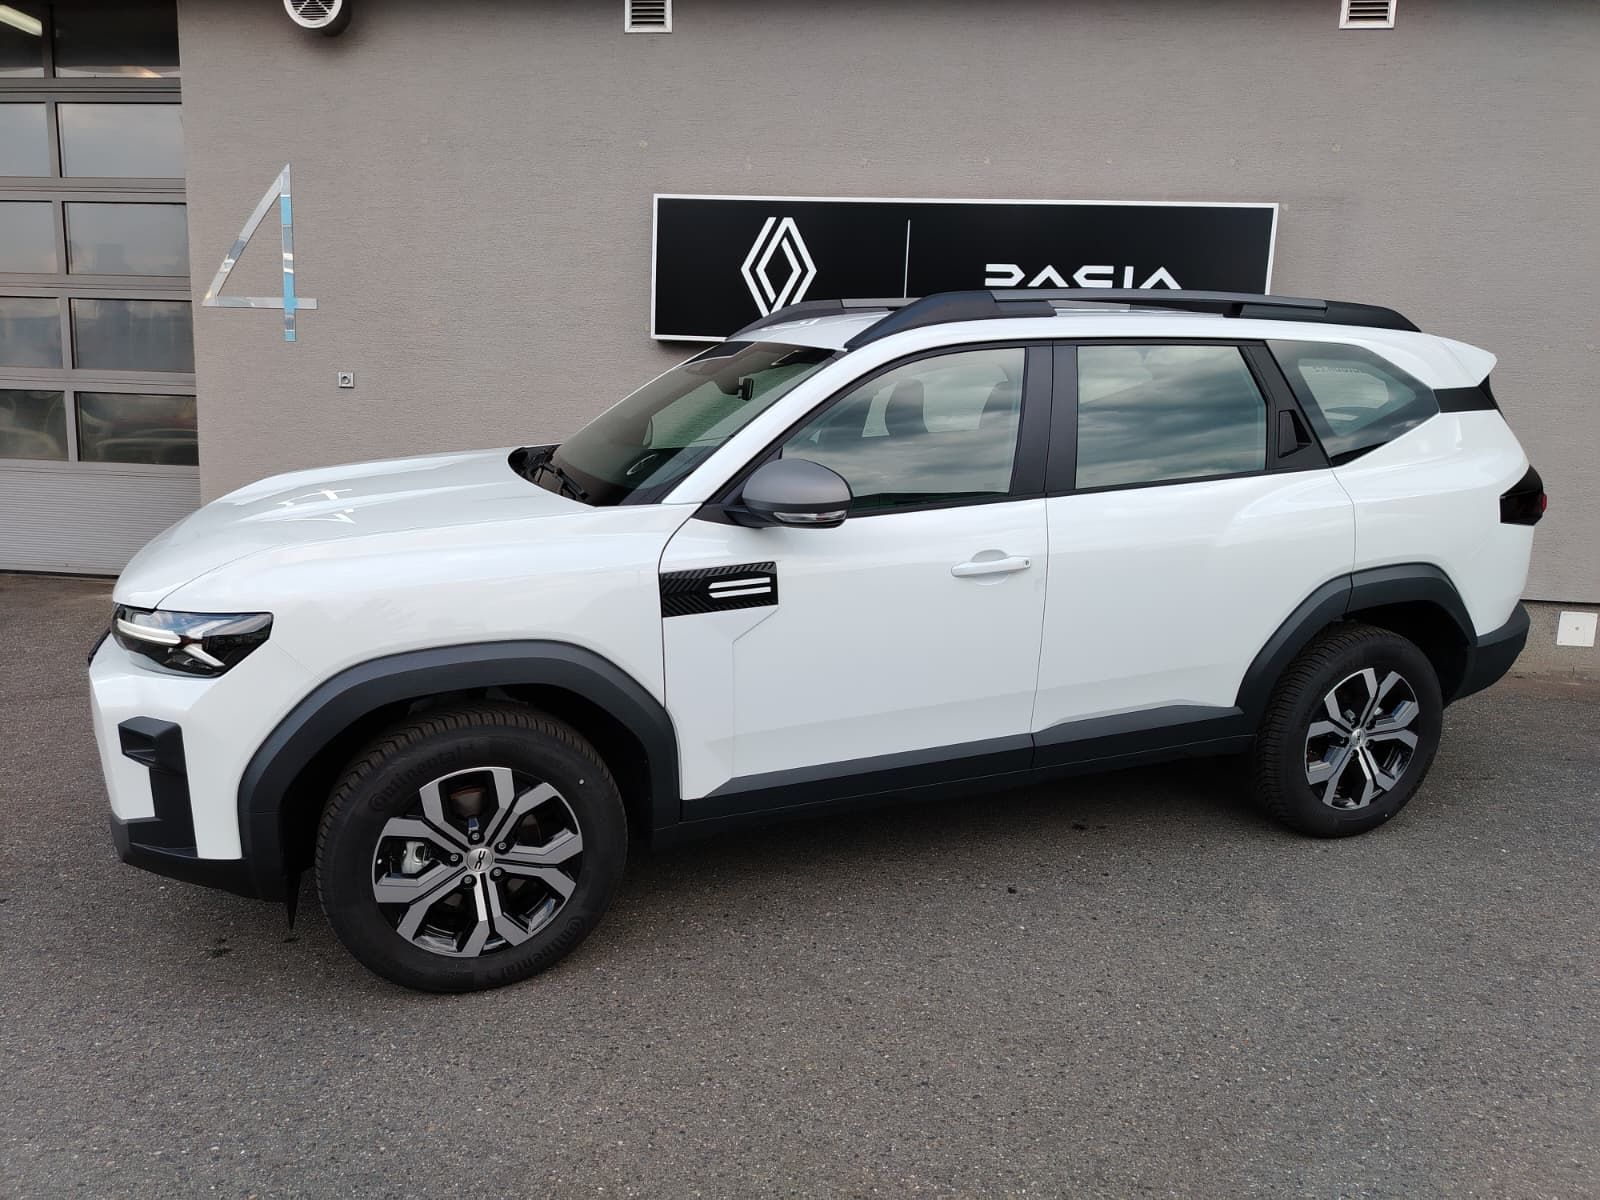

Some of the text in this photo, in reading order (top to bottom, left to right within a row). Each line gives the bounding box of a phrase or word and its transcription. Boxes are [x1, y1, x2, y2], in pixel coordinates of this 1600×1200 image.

[202, 163, 317, 341] 4
[985, 264, 1182, 289] DACIA
[370, 746, 462, 811] Continental
